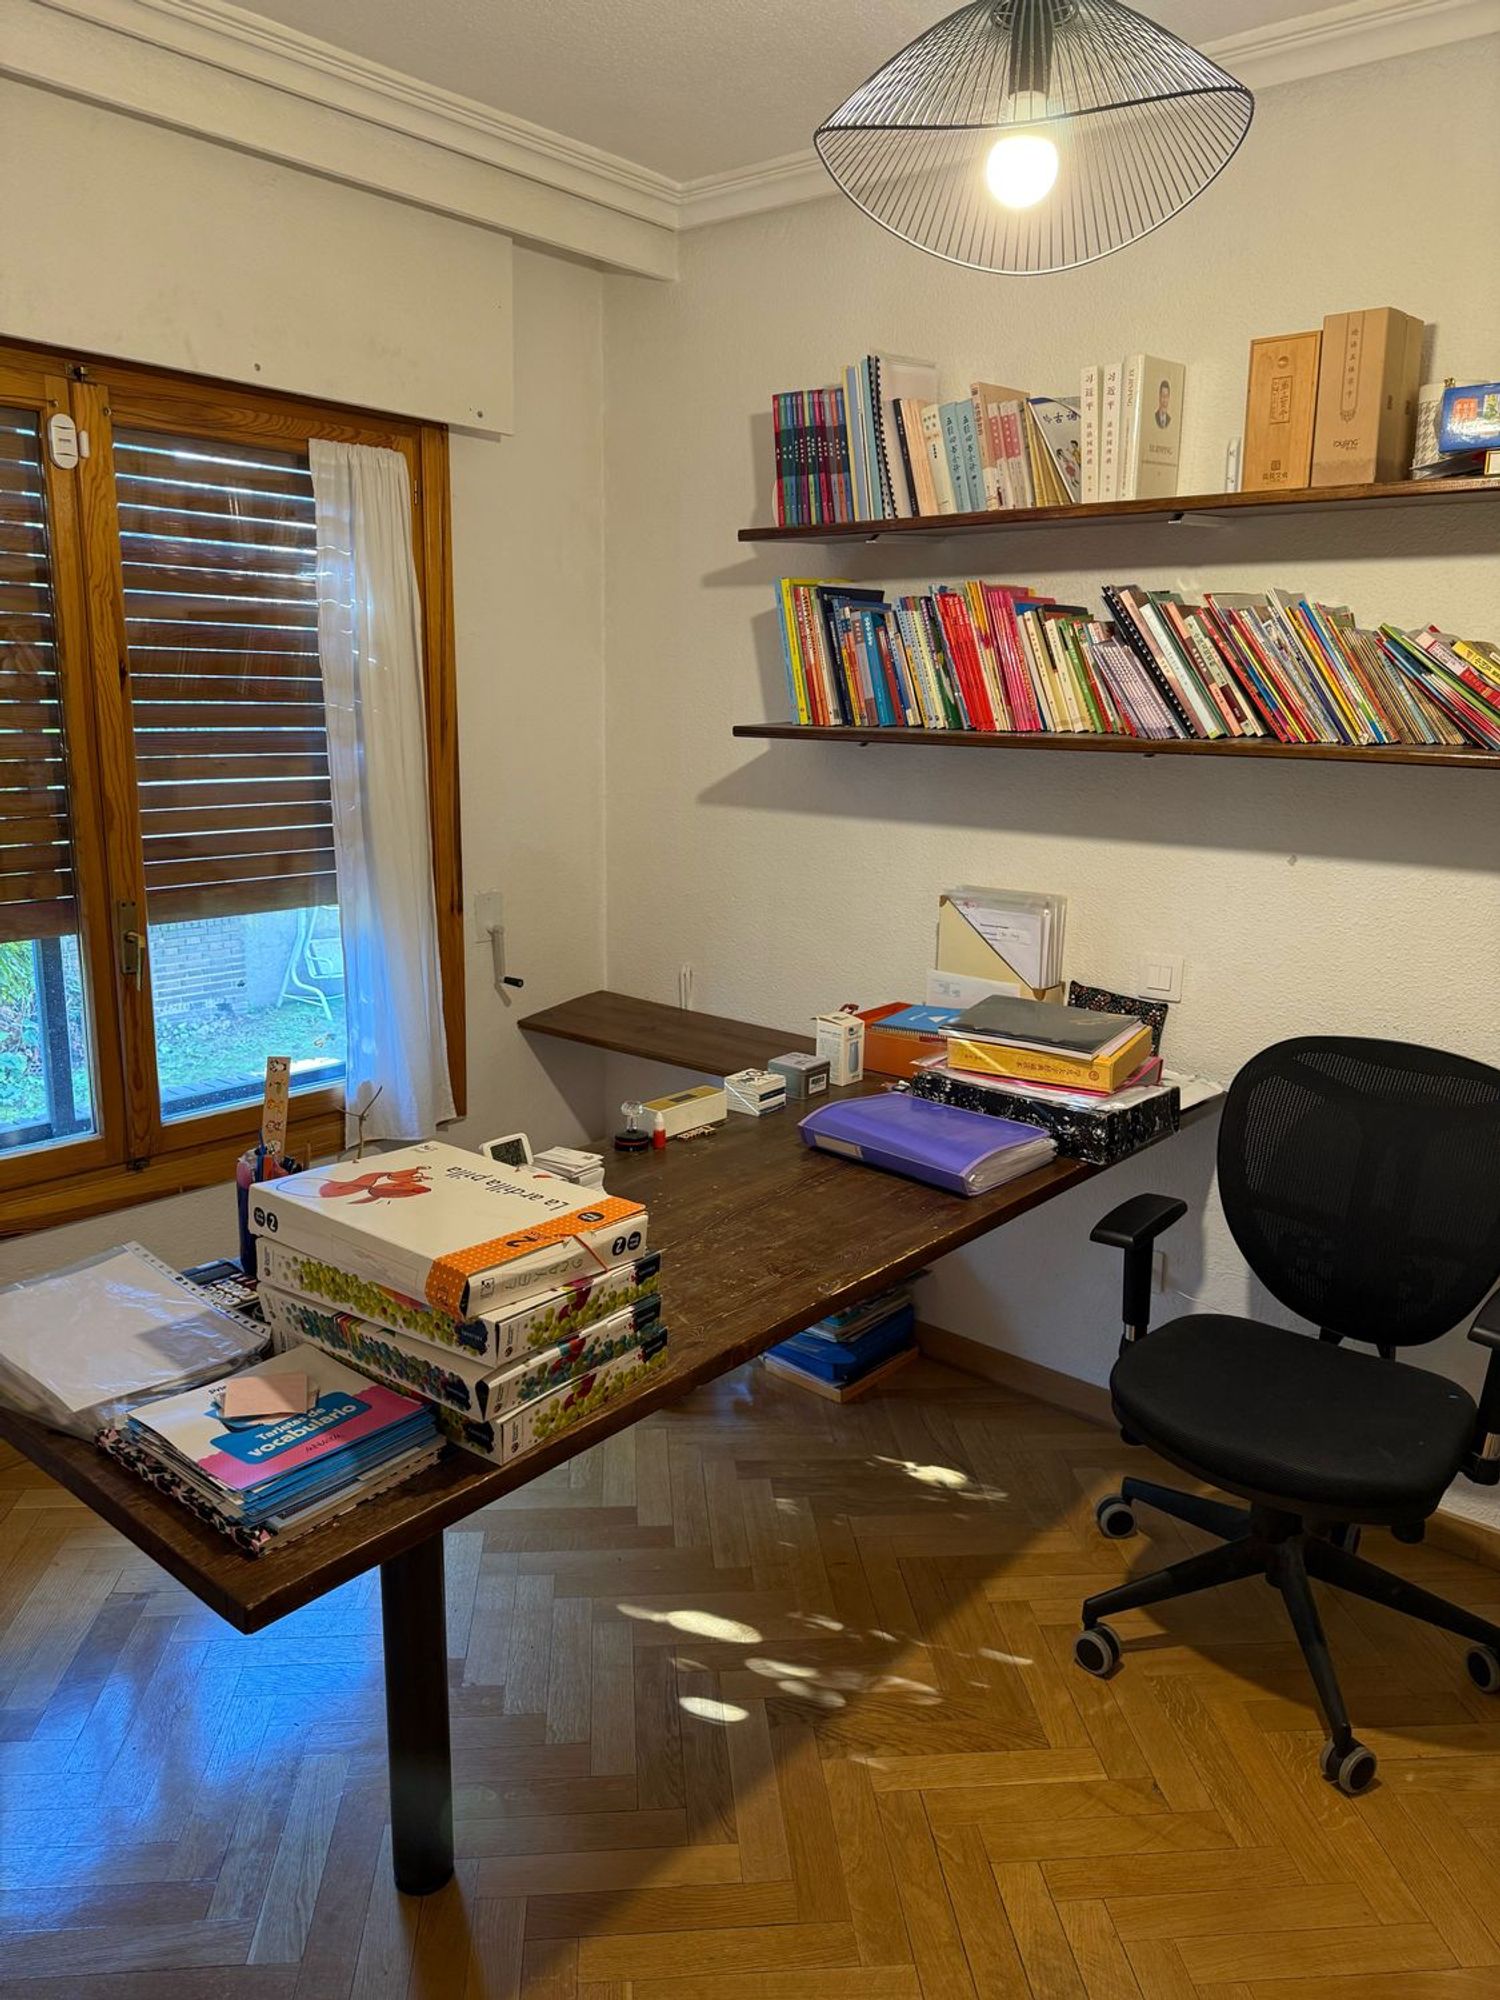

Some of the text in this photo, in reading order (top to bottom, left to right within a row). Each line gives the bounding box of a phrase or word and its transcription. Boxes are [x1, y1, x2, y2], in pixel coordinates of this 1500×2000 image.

[445, 1166, 570, 1211] La ardilla pilla
[248, 1404, 357, 1457] vocabulario
[308, 1407, 326, 1419] de
